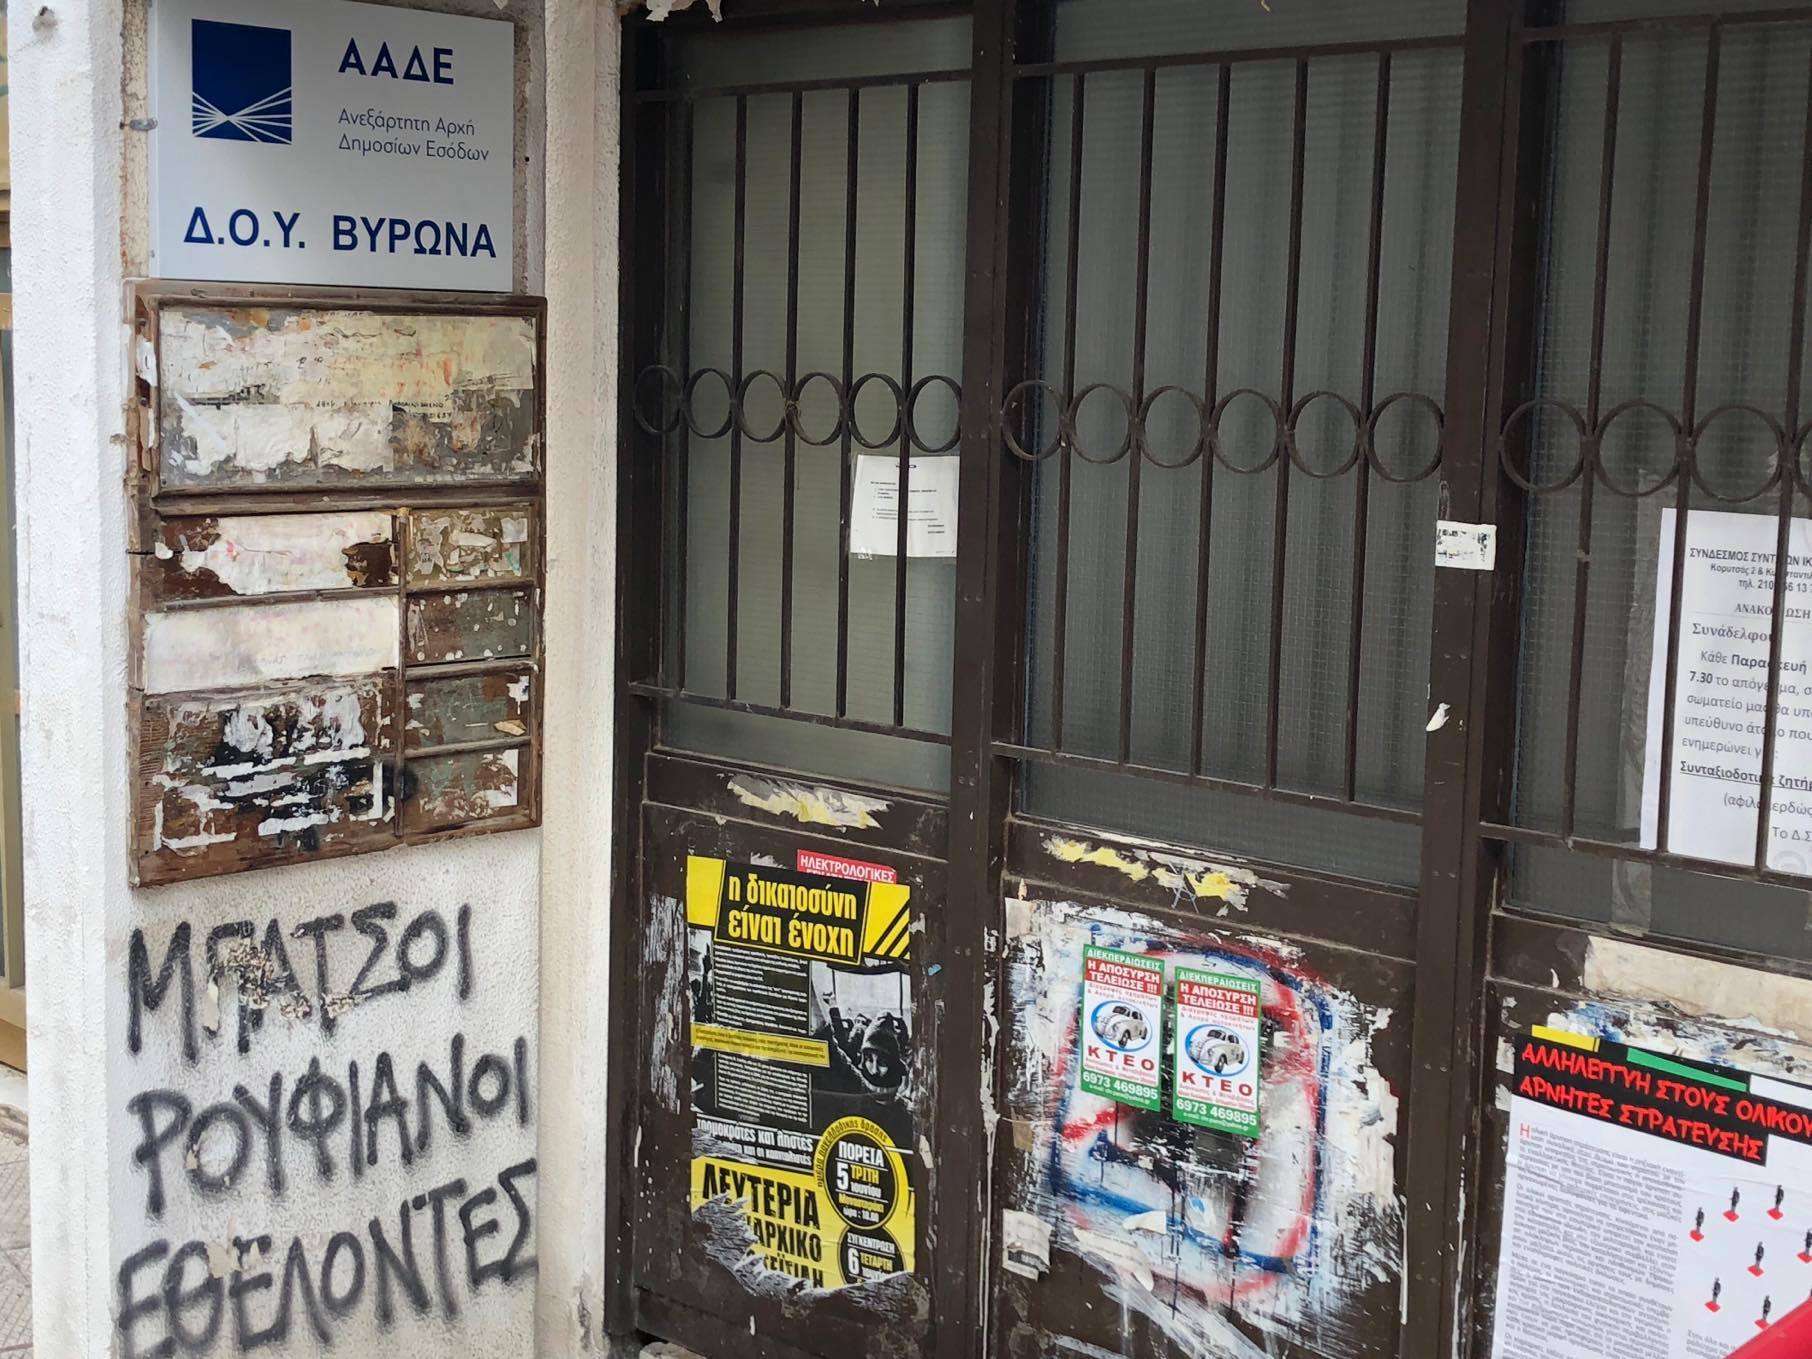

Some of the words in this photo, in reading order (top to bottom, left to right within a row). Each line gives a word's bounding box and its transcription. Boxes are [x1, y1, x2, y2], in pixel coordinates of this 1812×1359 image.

[338, 37, 454, 85] ΑΑΔΕ
[338, 108, 431, 133] Ανεξάρτητη
[435, 116, 476, 138] Αρχή
[338, 133, 421, 157] Δημοσίων
[425, 140, 490, 162] Εσόδων
[183, 206, 306, 250] Δ.Ο.Υ.
[332, 214, 498, 259] ΒΥΡΩΝΑ
[1689, 547, 1750, 563] ΣΥΝΔΕΣΜΟΣ
[1758, 579, 1774, 591] 210
[1734, 603, 1811, 619] ΑΝΑΚΟΩΣΗ
[1700, 650, 1728, 664] Κάθε
[1731, 654, 1808, 675] Παραευή
[1689, 670, 1713, 684] 7.30
[1715, 676, 1729, 686] το
[1687, 694, 1743, 710] σωματείο
[1685, 715, 1743, 732] υπεύθυνο
[1681, 738, 1752, 756] ενημερώνει
[1772, 826, 1788, 840] Το
[800, 855, 895, 883] ΗΛΕΚΤΡΟΛΟΓΙΚΕΣ
[728, 875, 741, 902] η
[746, 872, 857, 920] δικαιοσύνη
[728, 904, 782, 945] είναι
[788, 912, 854, 958] ένοχη
[1087, 948, 1161, 971] ΔΙΕΚΠΕΡΑΙΩΣΕΙΣ
[1087, 959, 1097, 970] Η
[1099, 962, 1160, 984] ΑΠΟΣΥΡΣΗ
[126, 901, 473, 1065] ΜΠΑΤΣΟΙ
[1089, 970, 1145, 992] ΤΕΛΕΙΩΣΕ
[1179, 970, 1257, 992] ΔΙΕΚΠΕΡΑΙΩΣΕΙΣ
[1180, 982, 1189, 994] Η
[1192, 985, 1257, 1006] ΑΠΟΣΥΡΣΗ
[1182, 994, 1241, 1013] ΤΕΛΕΙΩΣΕ
[1083, 1071, 1111, 1088] 6973
[1113, 1079, 1158, 1100] 469895
[1521, 1042, 1652, 1095] ΑΛΛΗΛΕΓΓΥΗ
[1655, 1079, 1730, 1116] ΣΤΟΥΣ
[126, 1032, 531, 1219] ΡΟΥΦΙΑΝΟΙ
[1176, 1099, 1207, 1115] 6973
[1210, 1106, 1257, 1126] 469895
[1519, 1075, 1615, 1118] ΑΡΝΗΤΕΣ
[1620, 1103, 1764, 1160] ΣΤΡΑΤΕΥΣΗΣ
[838, 1140, 885, 1168] ΠΟΡΕΙΑ
[836, 1161, 850, 1191] 5
[850, 1164, 880, 1185] ΤΡΙΤΗ
[702, 1163, 821, 1231] ΛΕΥΤΕΡΙΑ
[118, 1158, 538, 1359] ΕΘΕΛΟΝΤΕΣ
[847, 1247, 860, 1276] 6
